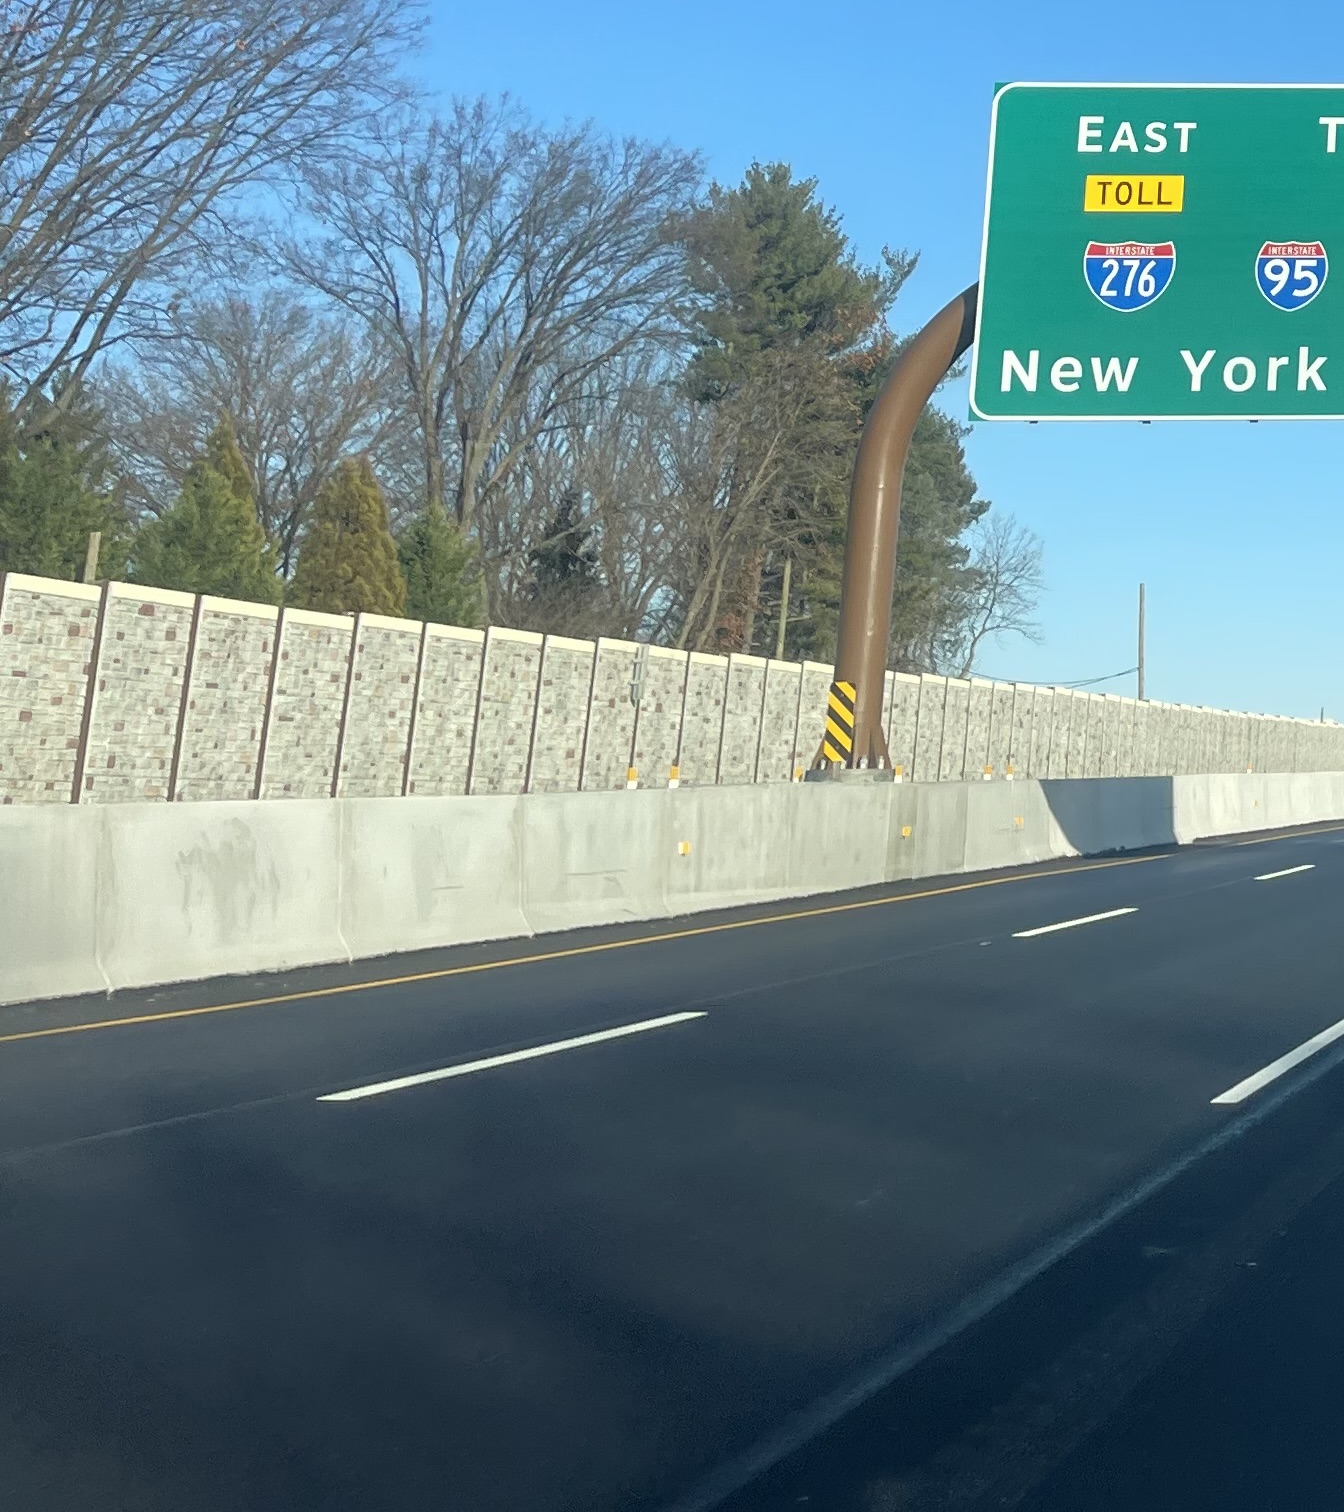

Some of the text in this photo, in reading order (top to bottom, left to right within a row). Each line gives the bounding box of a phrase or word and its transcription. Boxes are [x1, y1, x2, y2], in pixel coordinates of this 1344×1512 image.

[1077, 115, 1197, 153] EAST
[1097, 181, 1173, 206] TOLL
[1105, 245, 1156, 256] INTERSTATE
[1267, 245, 1317, 256] INTERSTATE
[1100, 258, 1157, 298] 276
[1263, 258, 1319, 298] 95
[1000, 349, 1139, 393] New
[1179, 346, 1328, 393] York
